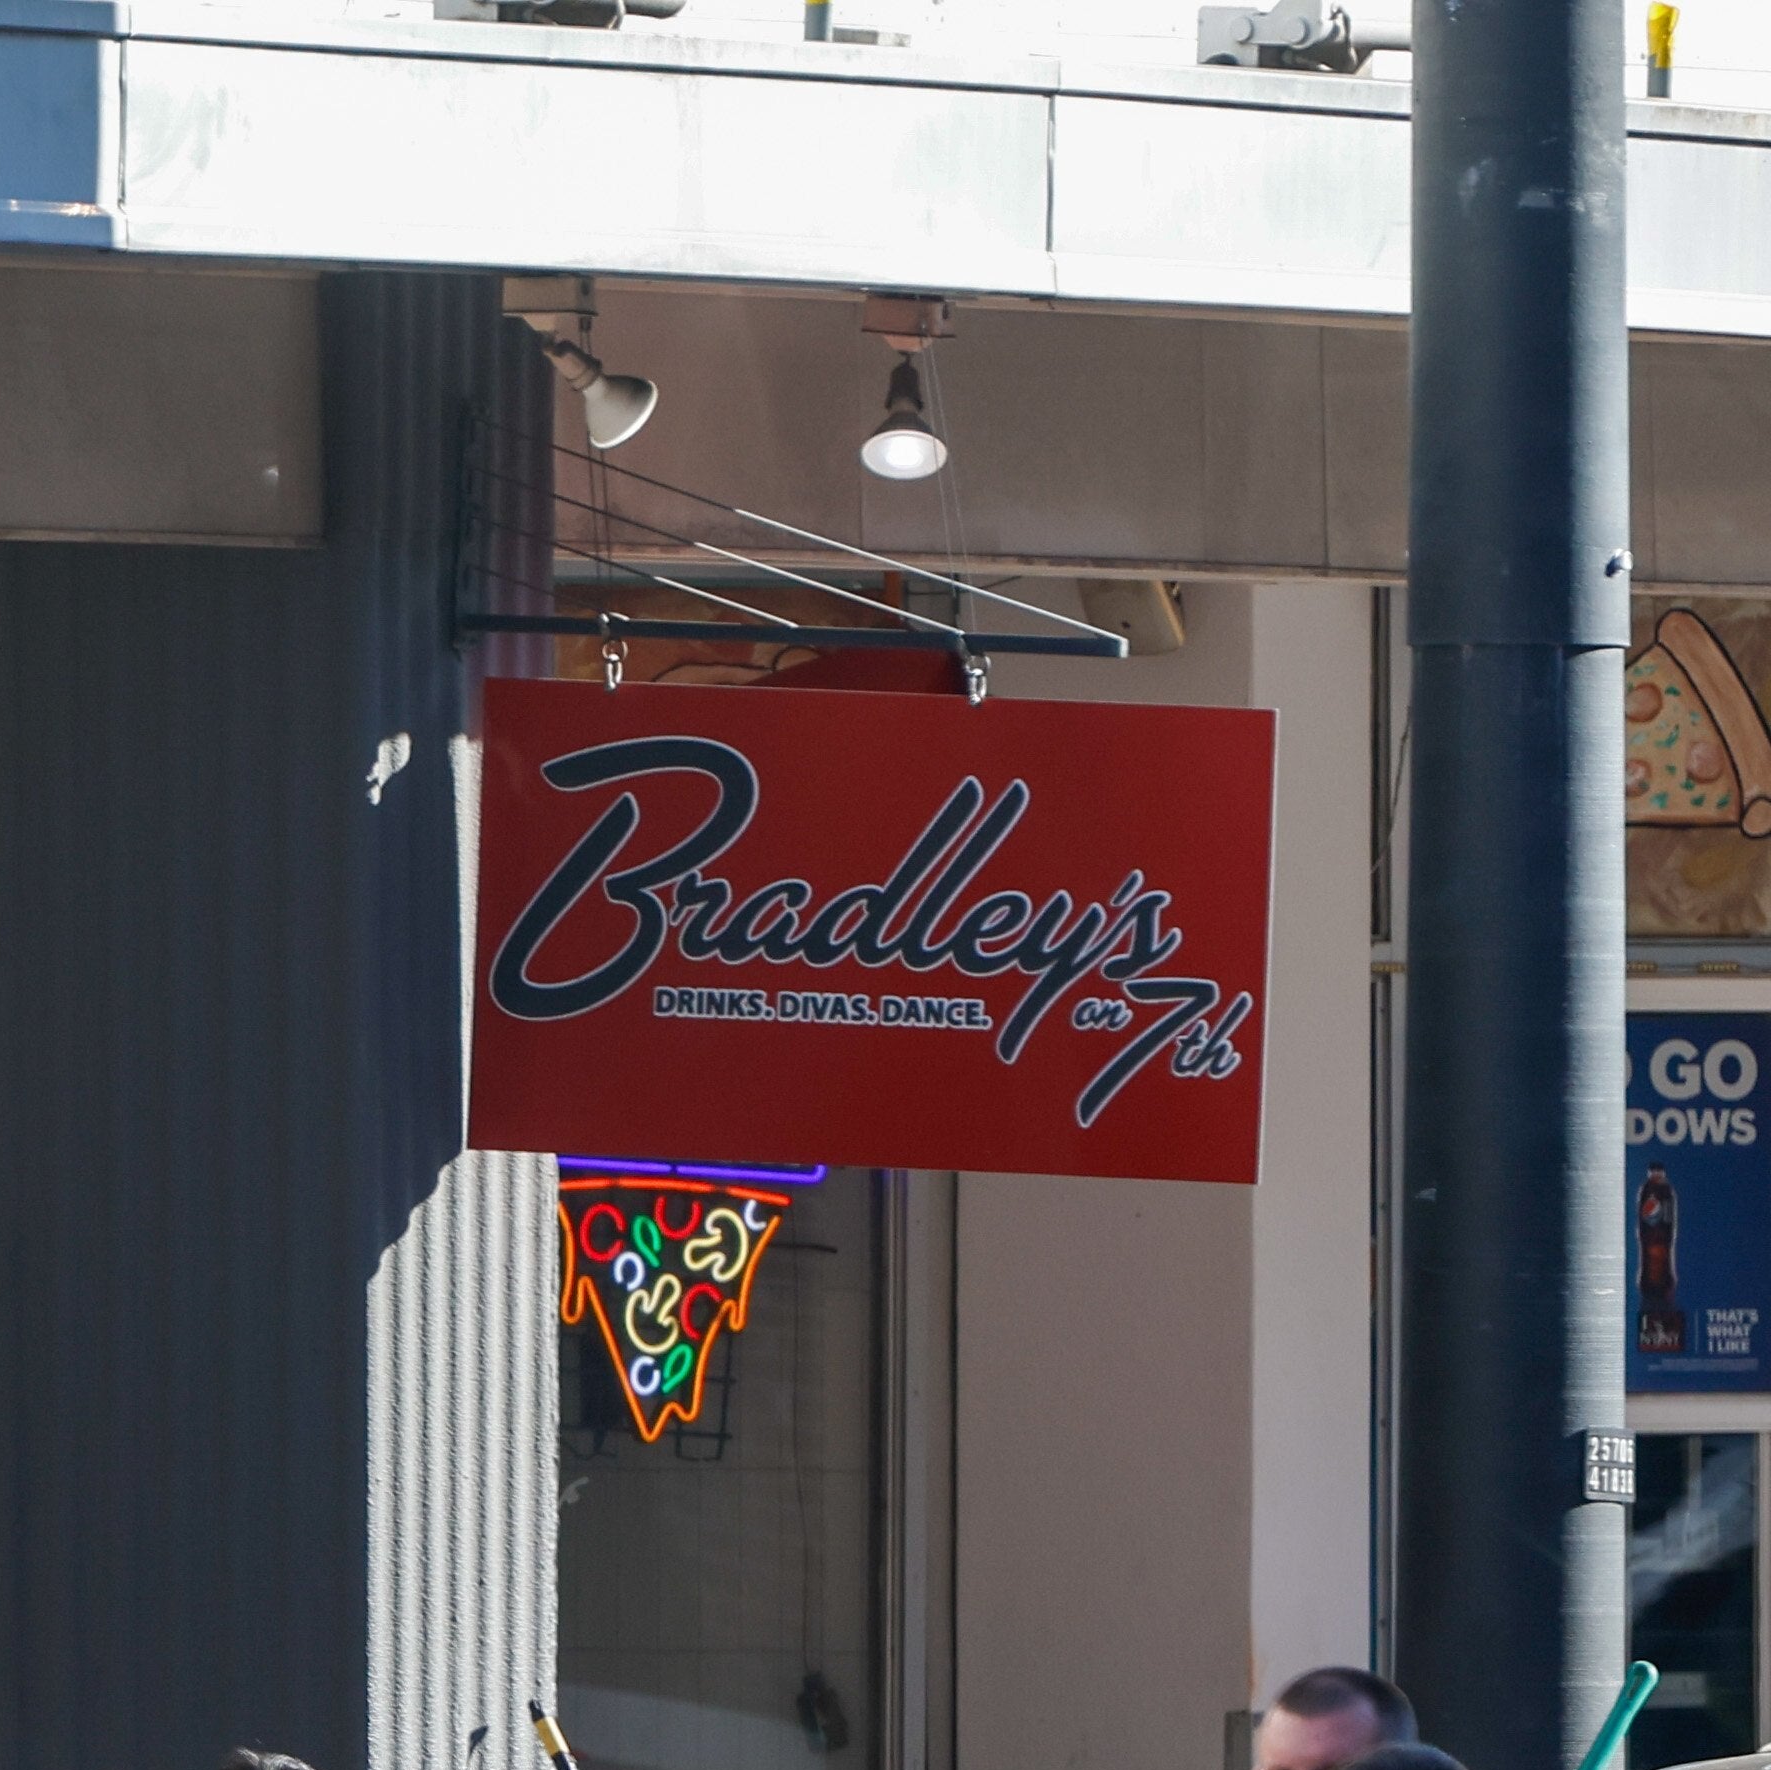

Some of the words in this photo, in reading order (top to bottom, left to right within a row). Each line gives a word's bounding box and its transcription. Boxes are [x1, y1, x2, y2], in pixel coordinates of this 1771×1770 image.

[489, 735, 1182, 1066] Bradley's
[653, 985, 775, 1020] DRINKS.
[778, 989, 878, 1025] DIVAS.
[880, 993, 992, 1031] DANCE.
[1071, 992, 1135, 1032] on
[1075, 976, 1252, 1129] 7th
[1649, 1038, 1759, 1101] GO
[1706, 1323, 1752, 1338] WHAT
